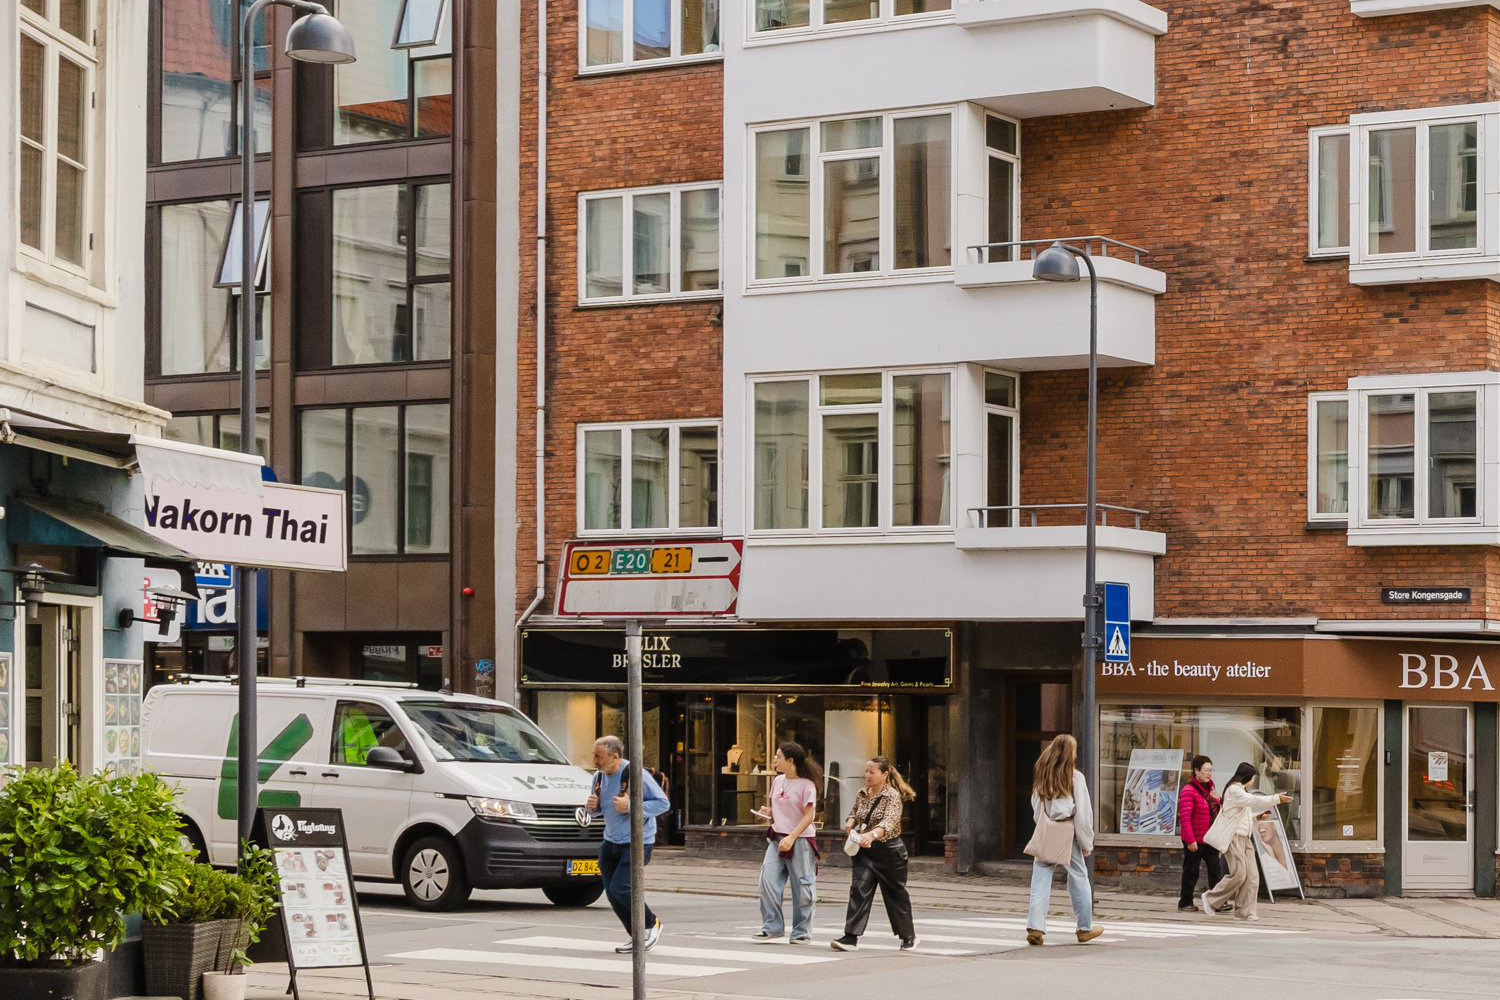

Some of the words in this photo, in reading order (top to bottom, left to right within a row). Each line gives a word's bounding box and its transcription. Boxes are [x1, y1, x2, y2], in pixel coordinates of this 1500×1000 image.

[144, 494, 252, 537] Nakorn
[262, 507, 328, 544] Thai
[615, 553, 647, 570] E20
[664, 552, 680, 568] 21
[1388, 590, 1410, 600] Store
[1411, 590, 1463, 601] Kongensgade
[624, 636, 671, 651] LIX
[1101, 662, 1136, 676] BBA
[1147, 660, 1169, 677] the
[1173, 660, 1221, 682] beauty
[1226, 661, 1272, 678] atelier
[1398, 653, 1496, 691] BBA
[572, 862, 583, 872] DZ
[584, 862, 593, 872] 84
